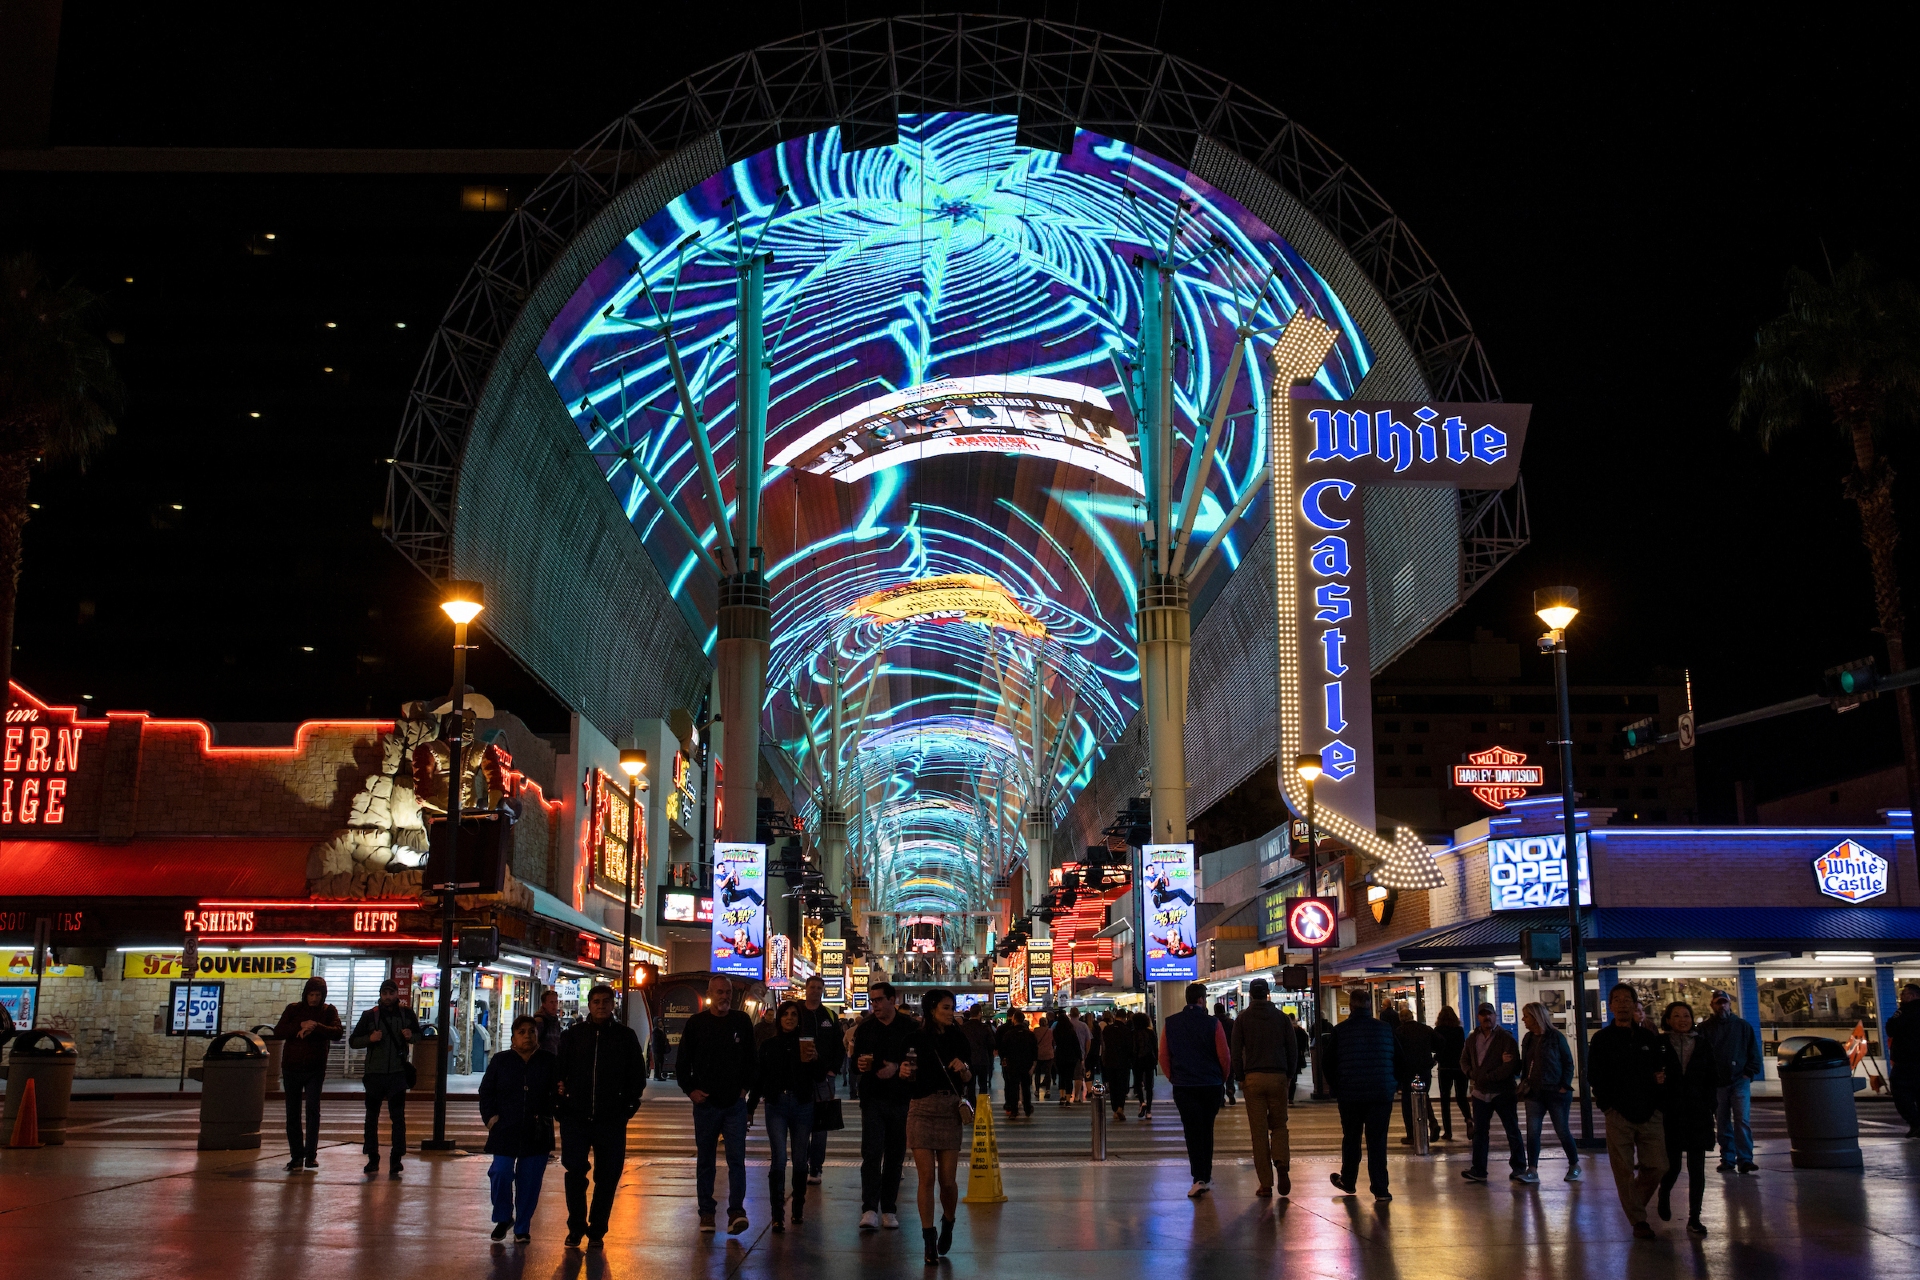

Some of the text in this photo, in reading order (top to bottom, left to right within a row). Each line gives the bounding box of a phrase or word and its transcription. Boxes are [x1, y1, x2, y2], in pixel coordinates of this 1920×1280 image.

[1307, 406, 1508, 473] White
[1301, 478, 1358, 782] Castle
[1476, 750, 1519, 765] MOTOR
[1458, 769, 1539, 783] HARLEY-DAVIDSON
[1495, 834, 1580, 863] NOW
[1491, 857, 1588, 886] OPEN
[1825, 859, 1878, 877] White
[1824, 875, 1882, 891] Castle
[1501, 881, 1570, 908] 24/7
[0, 912, 82, 931] SOUIRS
[184, 911, 254, 932] T-SHIRTS
[354, 911, 398, 932] GIFTS
[722, 908, 757, 921] TWO WAYS
[728, 916, 751, 926] TO FLY
[1152, 908, 1188, 922] TWO WAYS
[1159, 916, 1182, 928] TO FLY
[177, 1000, 186, 1012] 2
